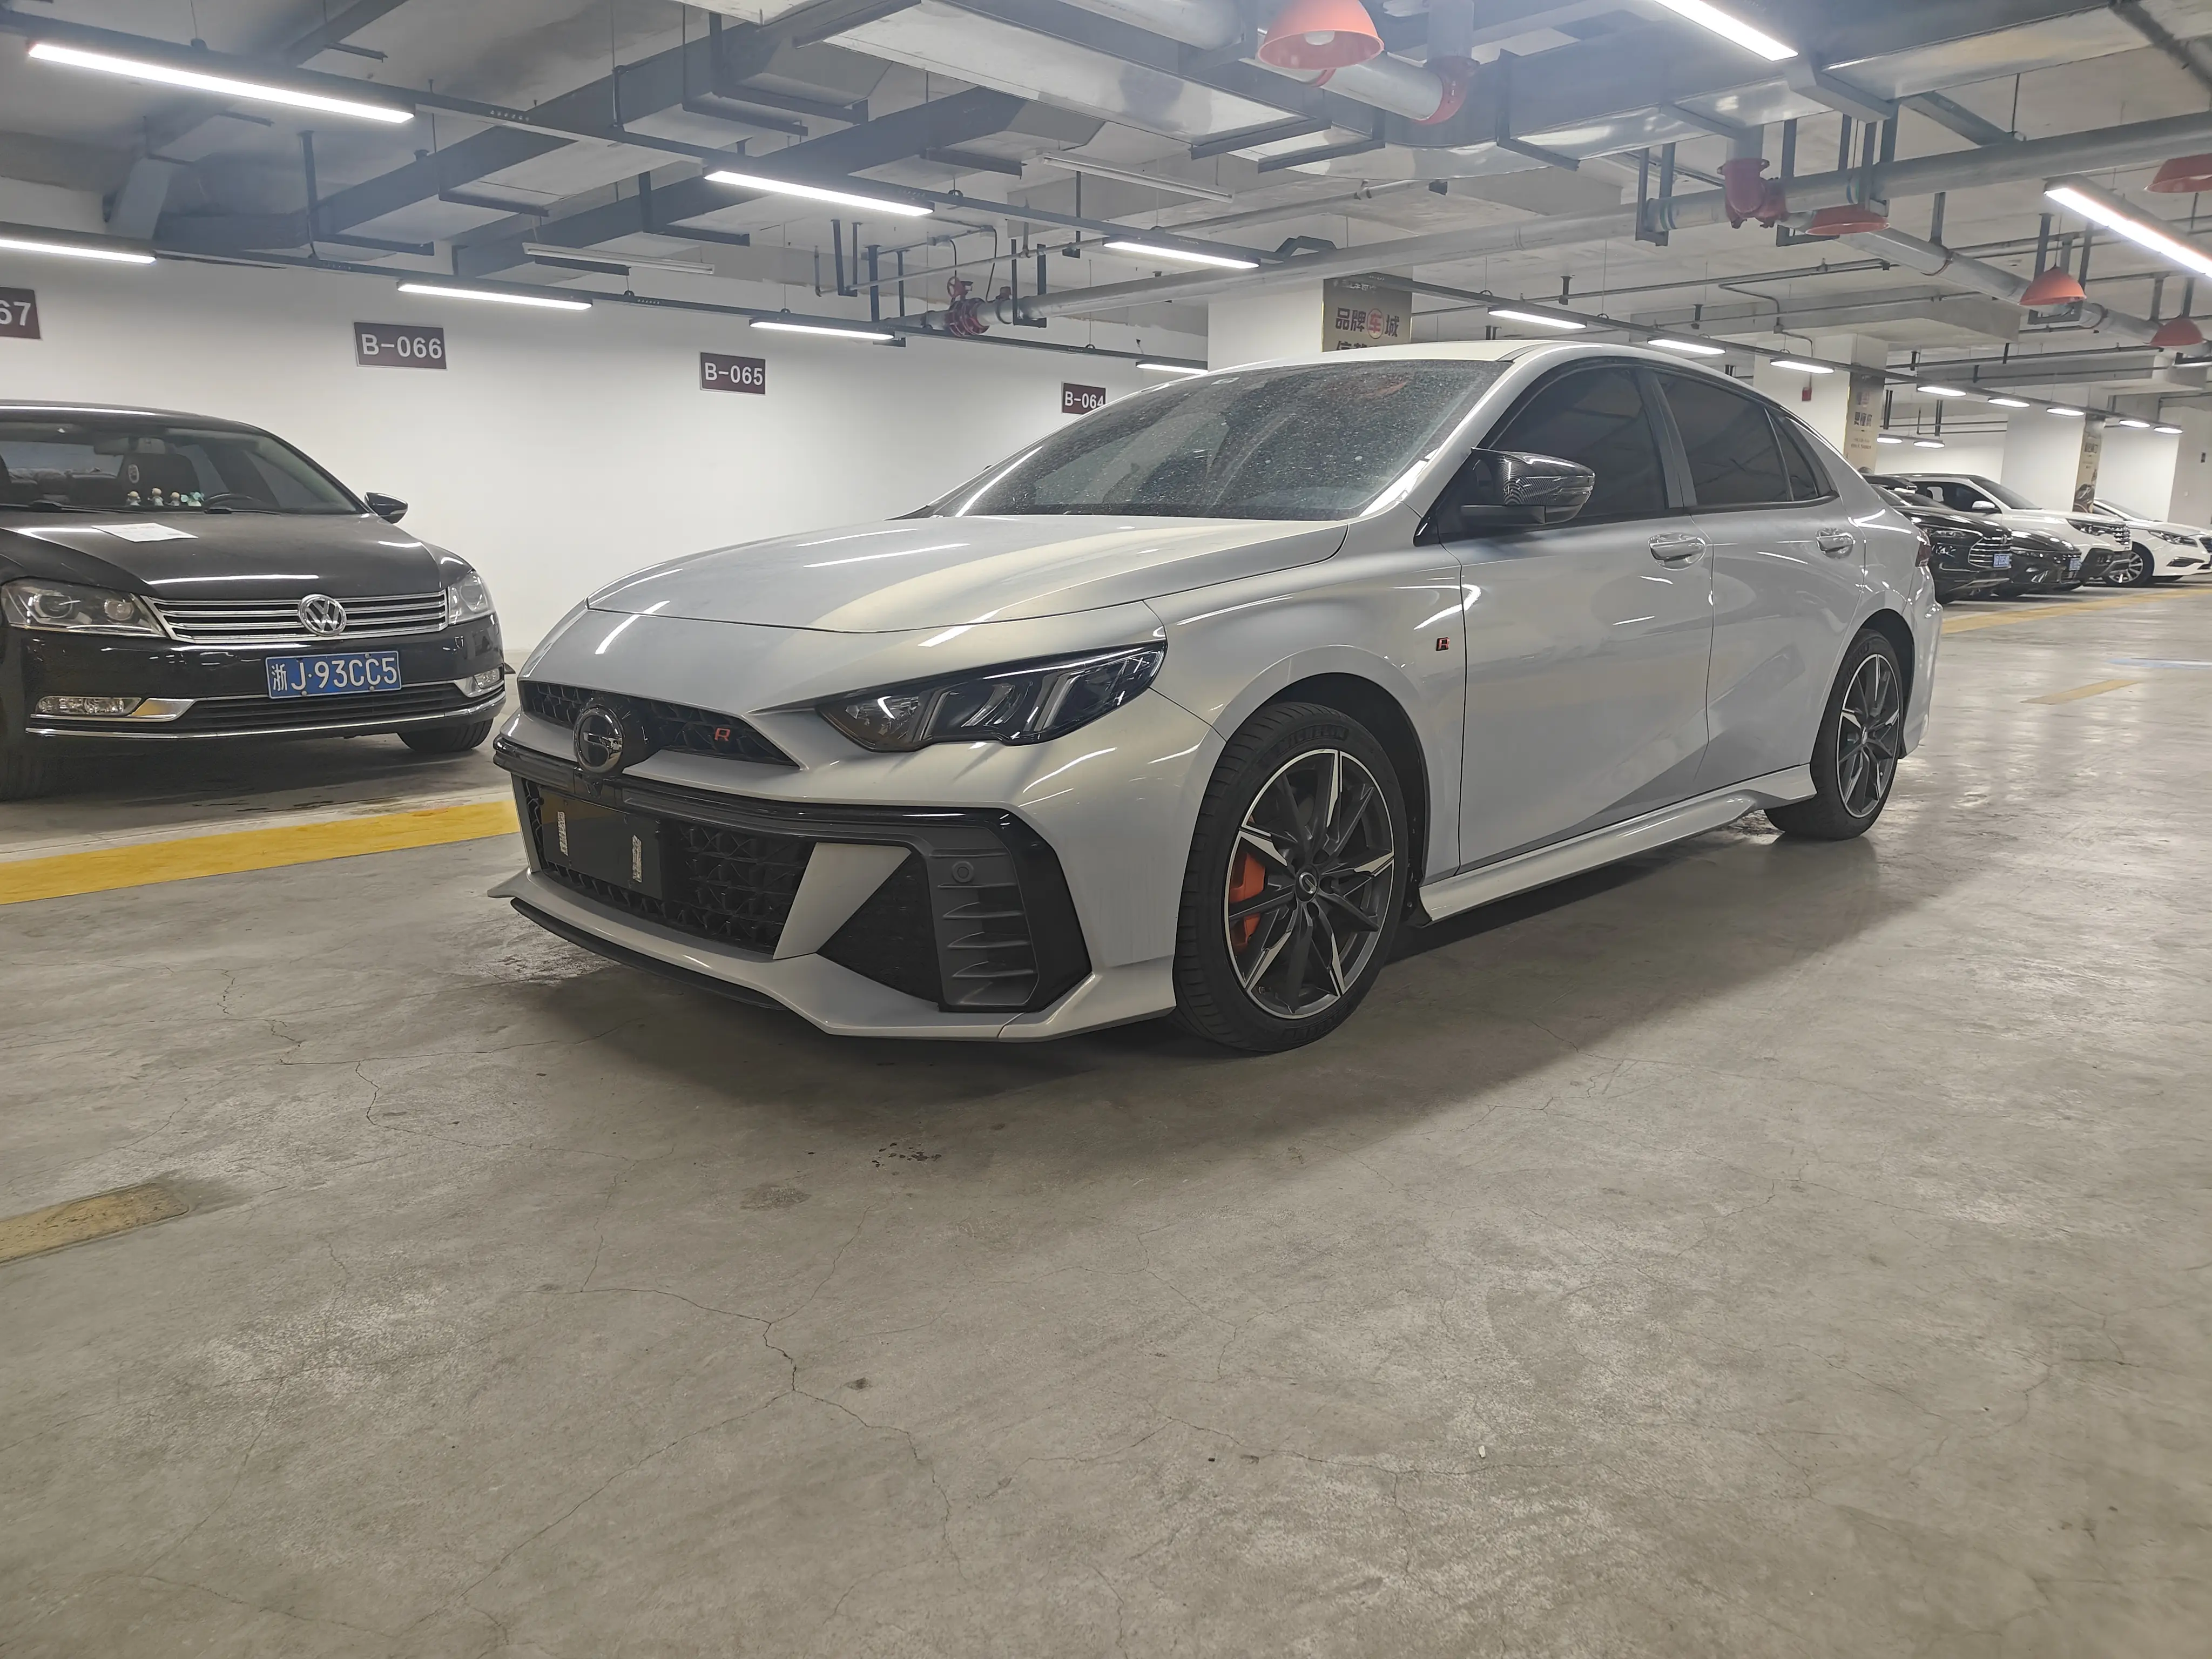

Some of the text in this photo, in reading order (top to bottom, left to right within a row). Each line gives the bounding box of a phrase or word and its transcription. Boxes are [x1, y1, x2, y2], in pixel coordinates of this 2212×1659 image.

[1336, 307, 1400, 339] 品牌车城
[361, 333, 442, 359] B-066
[705, 362, 763, 386] B-065
[1065, 390, 1104, 409] B-064
[1438, 637, 1450, 650] R
[714, 727, 731, 741] R
